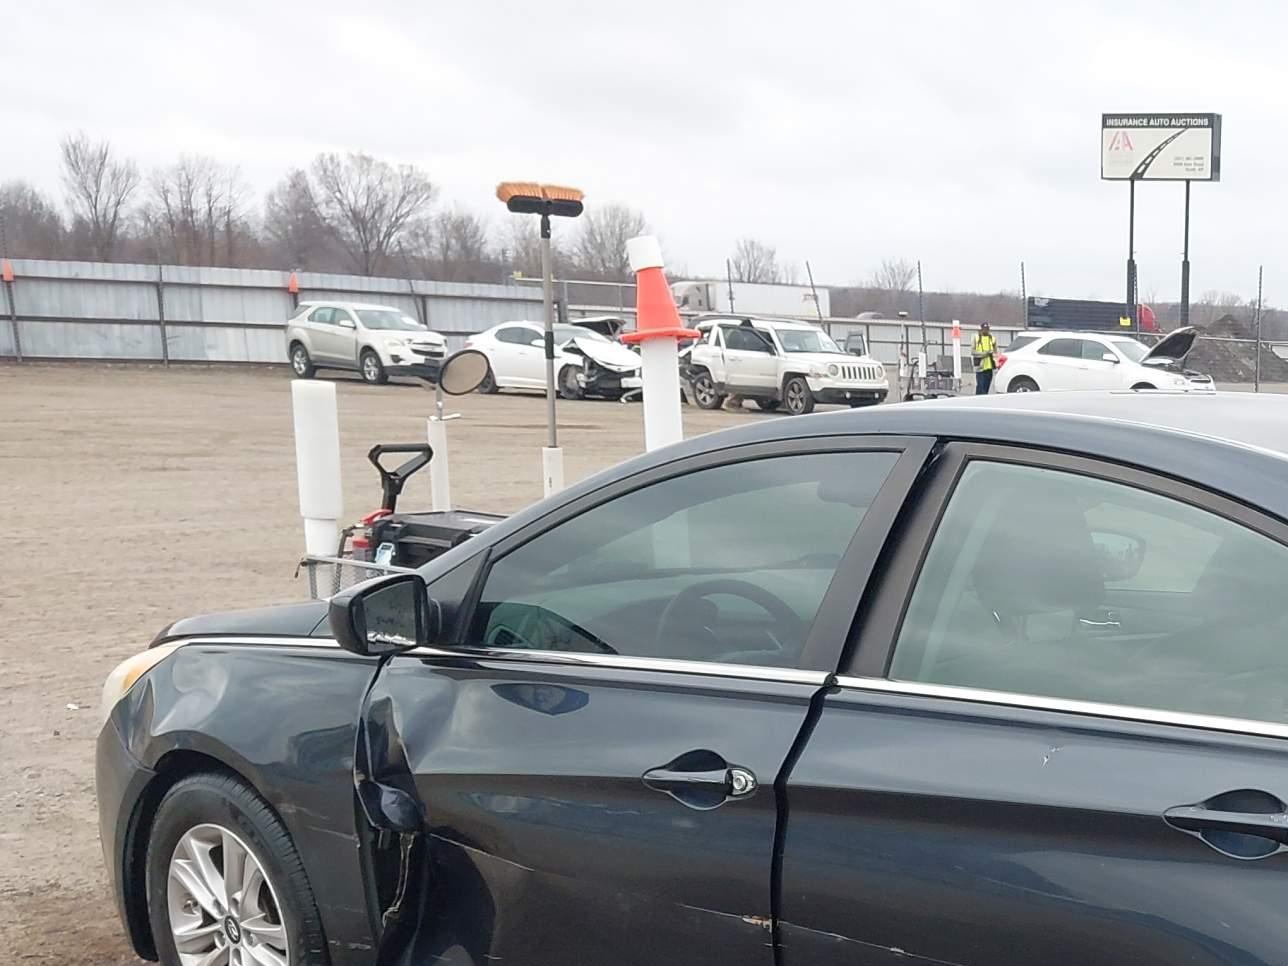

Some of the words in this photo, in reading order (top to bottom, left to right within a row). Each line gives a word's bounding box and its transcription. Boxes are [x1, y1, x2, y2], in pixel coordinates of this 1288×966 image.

[1106, 118, 1148, 127] INSURANCE
[1149, 118, 1170, 127] AUTO
[1171, 118, 1209, 127] AUCTIONS
